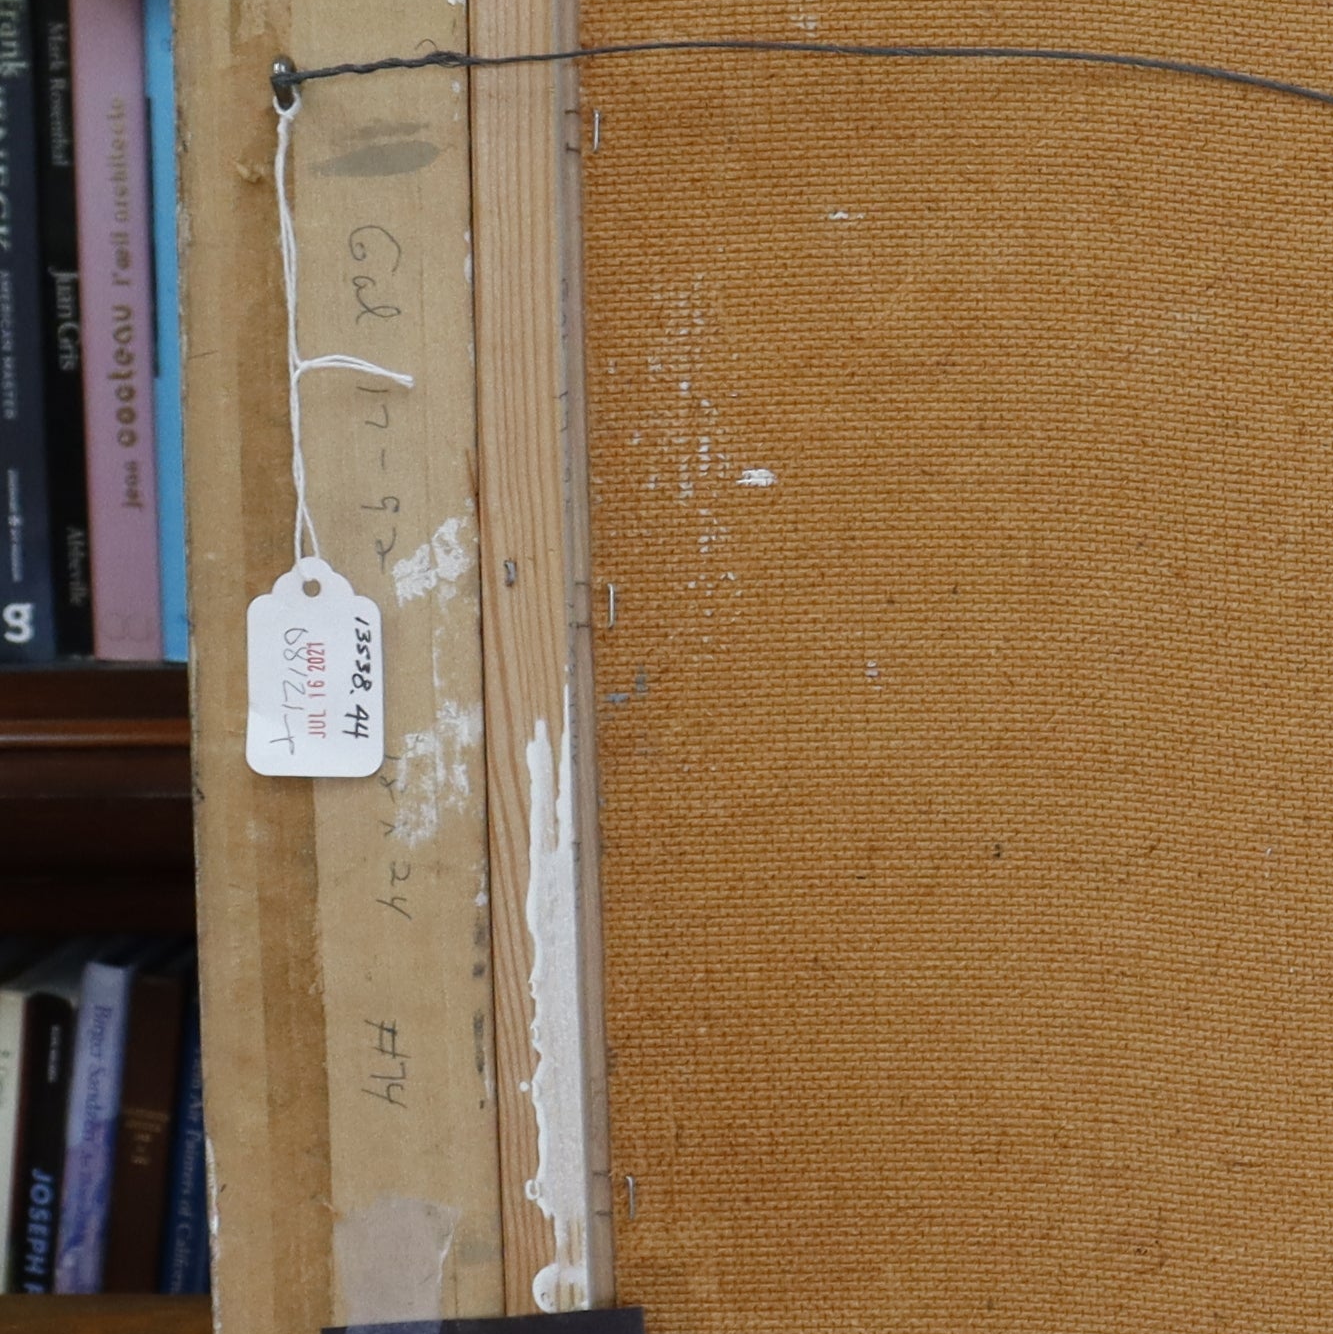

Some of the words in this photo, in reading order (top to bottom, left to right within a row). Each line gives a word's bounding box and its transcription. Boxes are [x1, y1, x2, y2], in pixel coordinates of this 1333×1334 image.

[48, 265, 75, 318] Juan
[56, 321, 77, 370] Gris
[112, 302, 140, 449] cocteau
[307, 640, 325, 677] 2021
[308, 677, 325, 700] 16
[308, 710, 326, 738] JUL
[25, 1167, 54, 1274] JOSEPH
